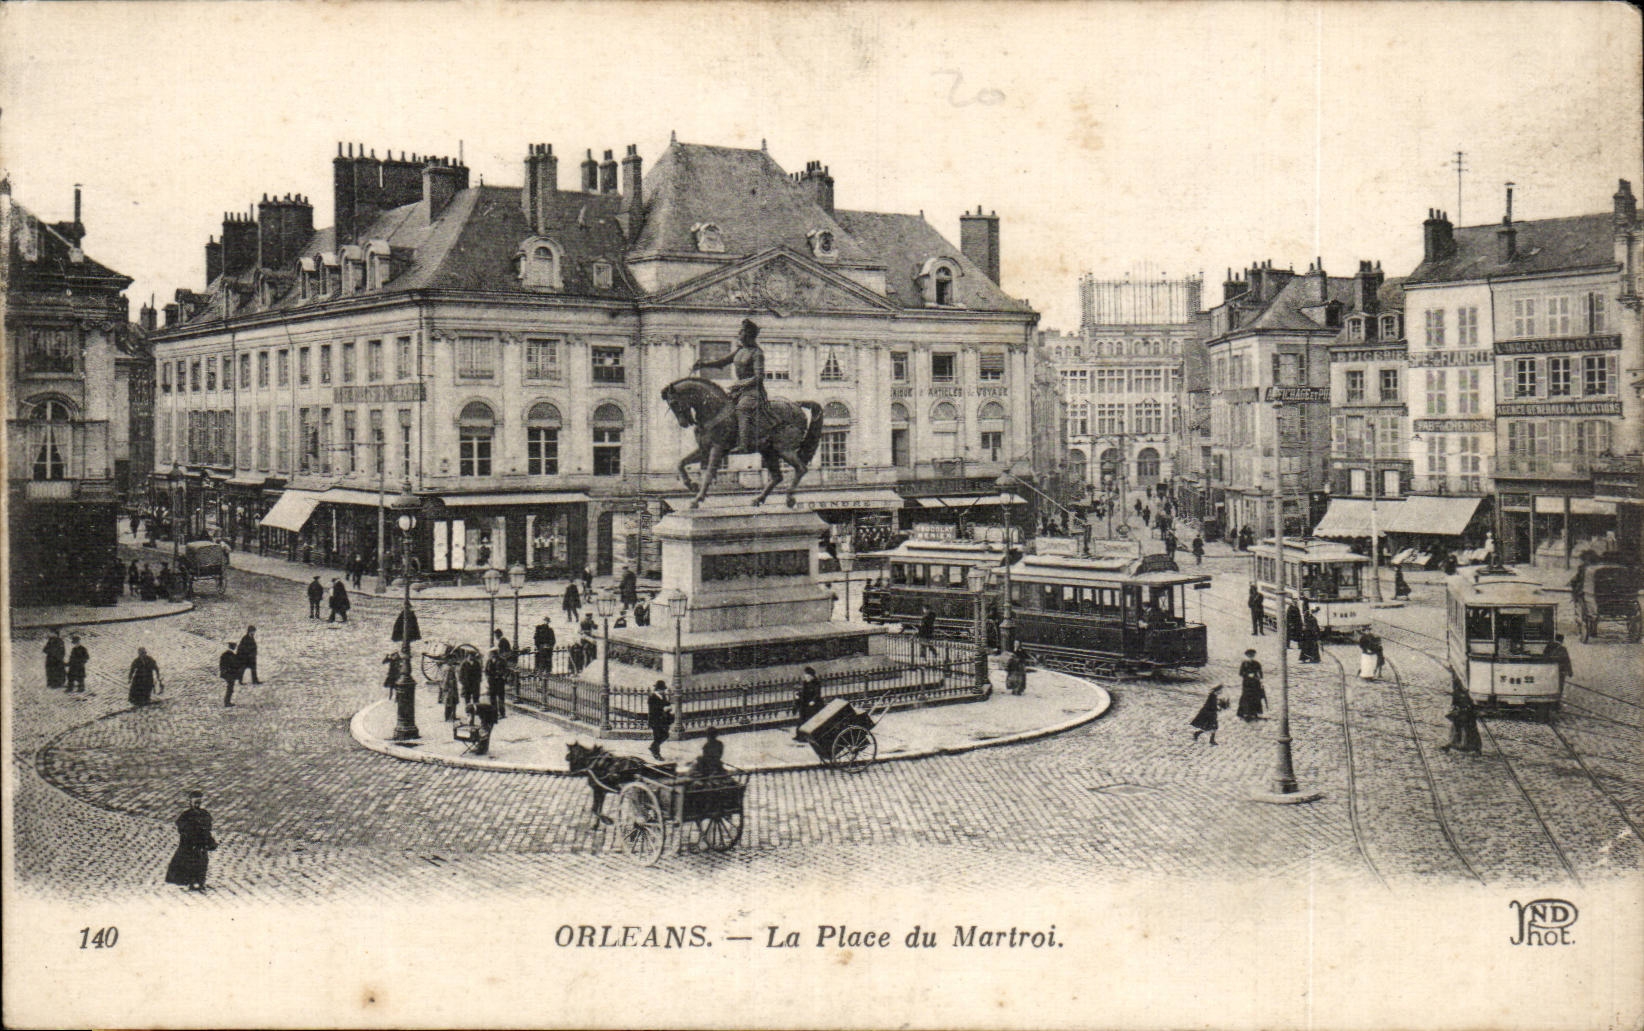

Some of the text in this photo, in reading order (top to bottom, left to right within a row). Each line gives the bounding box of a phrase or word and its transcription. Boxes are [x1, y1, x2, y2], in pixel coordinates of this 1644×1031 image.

[1575, 337, 1617, 350] CENTRE
[1440, 351, 1495, 366] FLANELLE
[927, 387, 962, 398] ARTICLES
[976, 387, 1009, 398] VOYAGE
[1575, 402, 1621, 414] LOCATIONS
